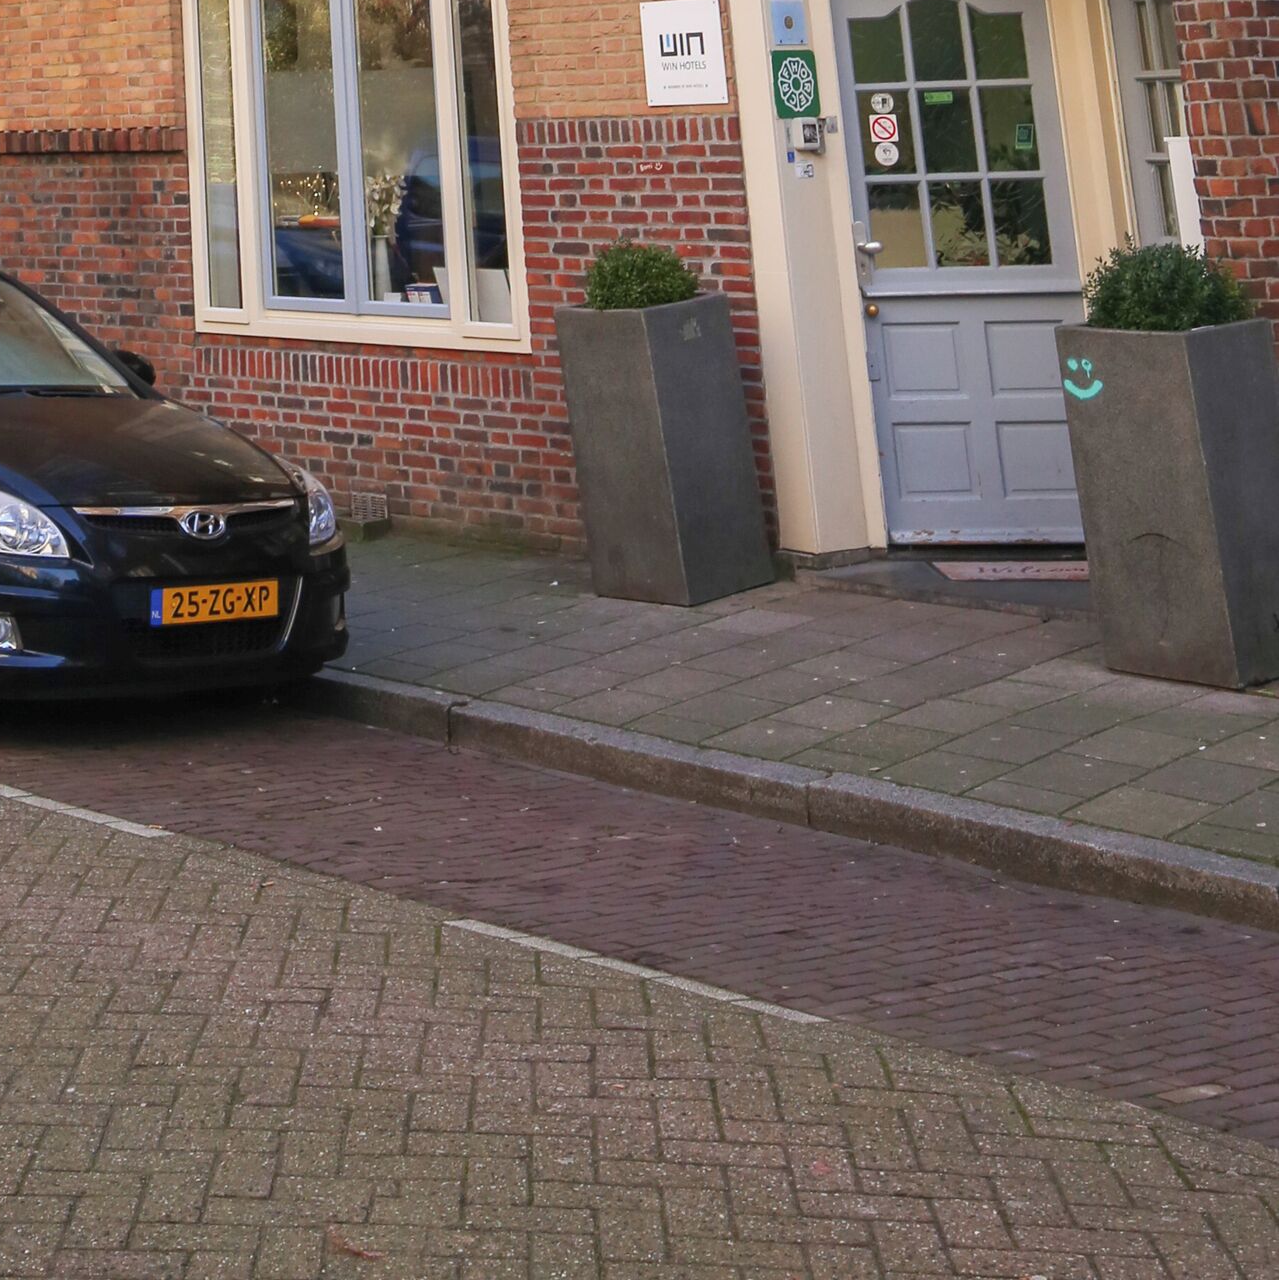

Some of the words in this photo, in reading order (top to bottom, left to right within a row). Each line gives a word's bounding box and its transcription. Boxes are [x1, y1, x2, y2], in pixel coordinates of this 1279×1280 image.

[662, 61, 678, 71] WIN
[679, 60, 707, 70] HOTELS
[151, 610, 161, 619] NL
[172, 585, 270, 618] 25-ZG-XP
